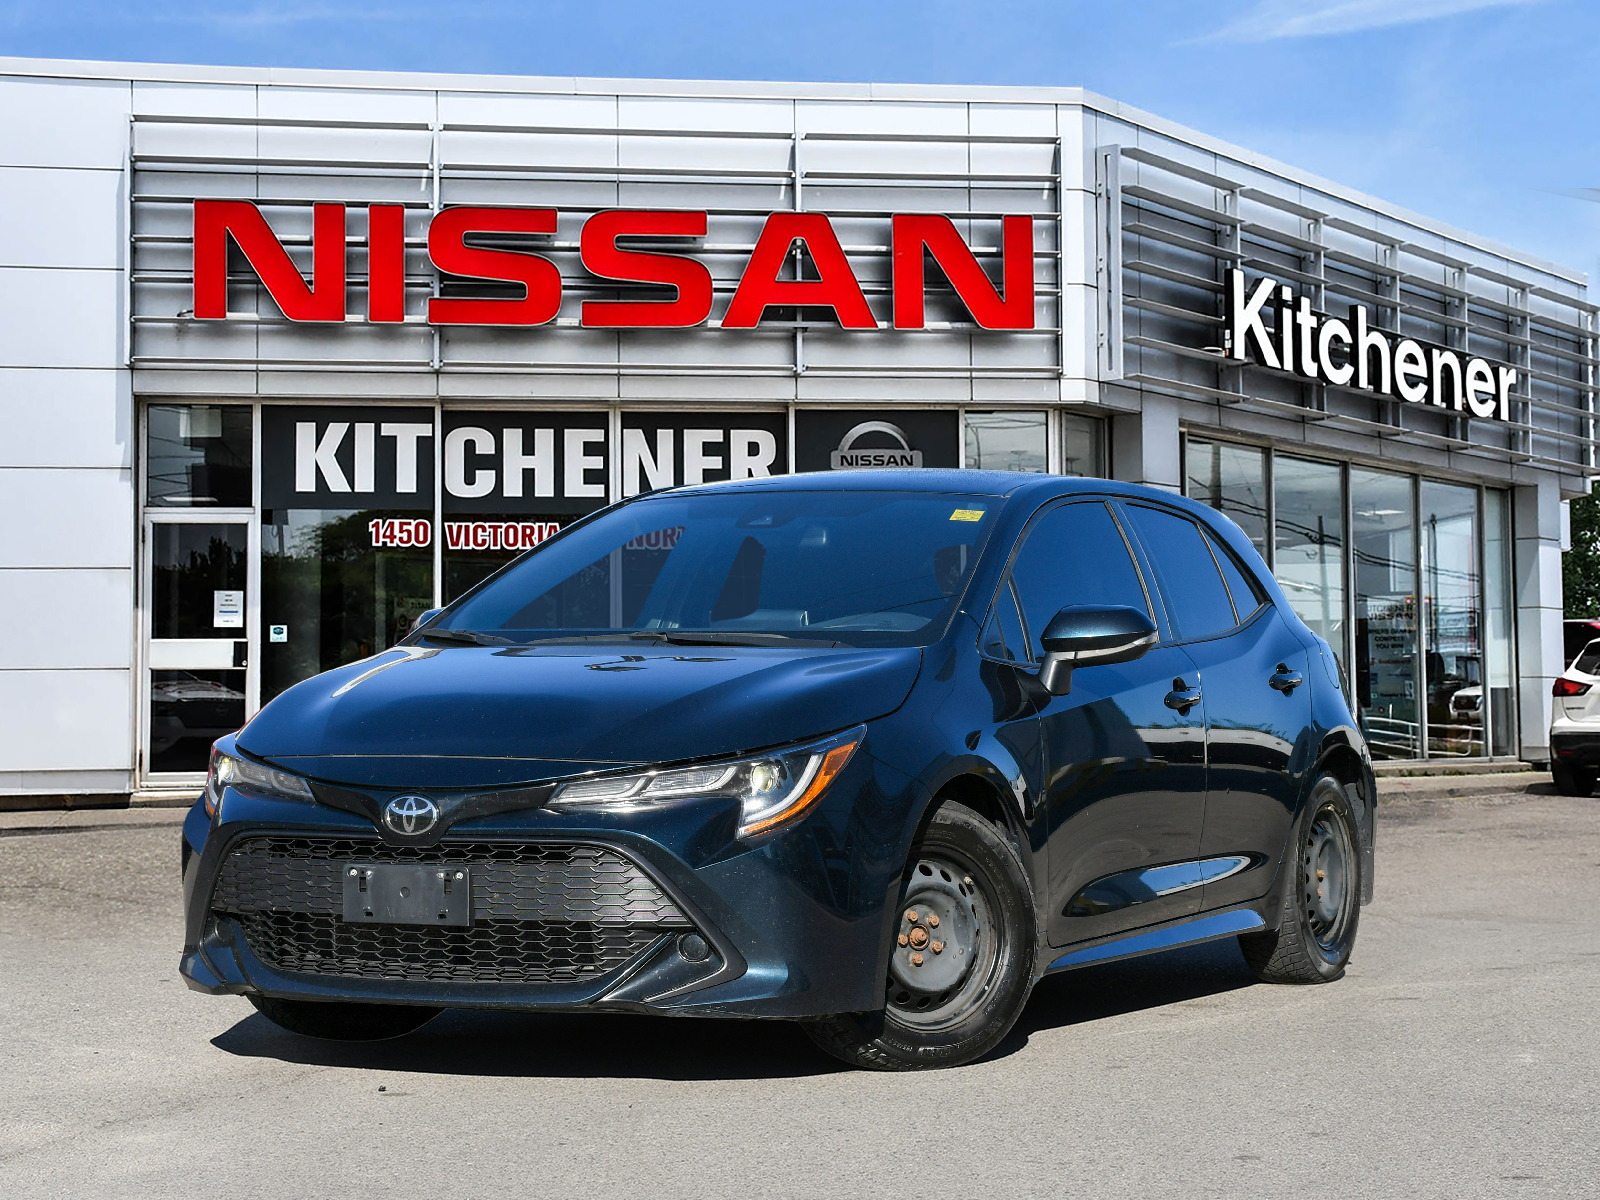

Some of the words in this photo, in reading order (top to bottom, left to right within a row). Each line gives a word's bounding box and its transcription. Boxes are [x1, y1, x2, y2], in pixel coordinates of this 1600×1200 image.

[193, 200, 1035, 330] NISSAN
[1231, 268, 1518, 422] Kitchener
[294, 421, 778, 498] KITCHENER
[840, 454, 914, 467] NISSAN
[368, 519, 432, 547] 1450
